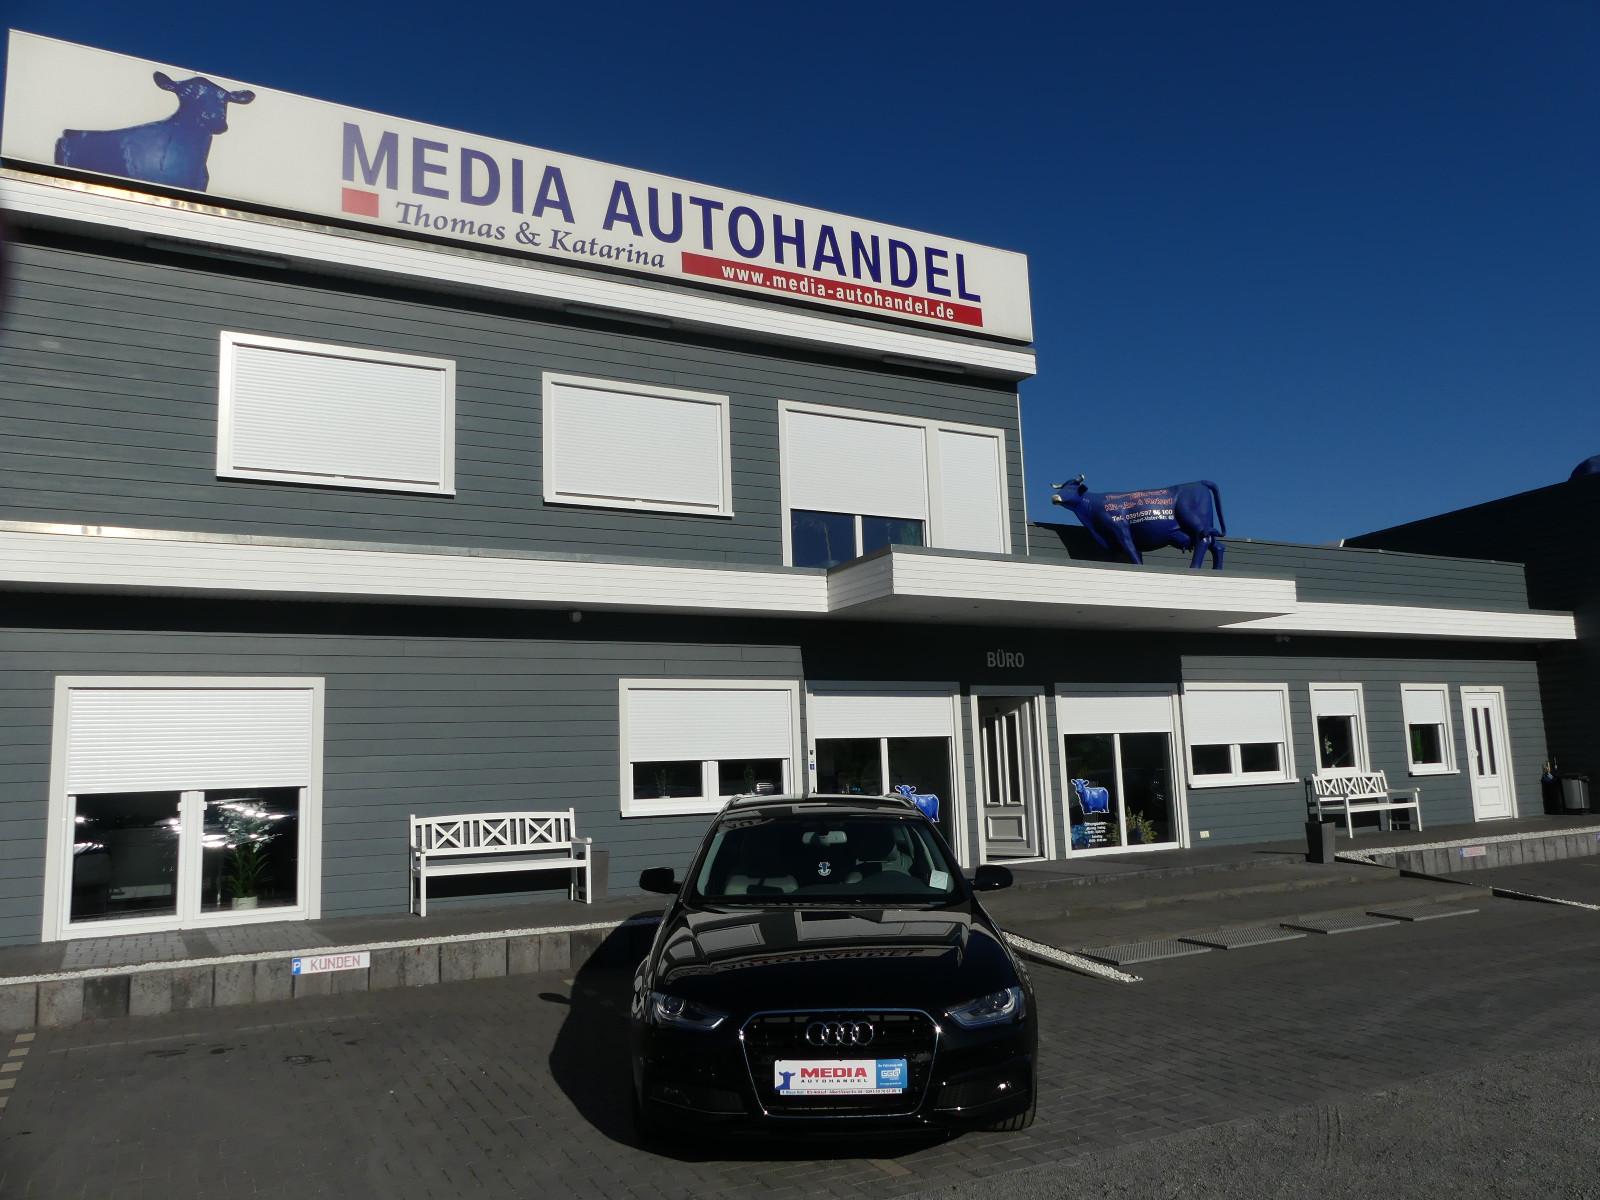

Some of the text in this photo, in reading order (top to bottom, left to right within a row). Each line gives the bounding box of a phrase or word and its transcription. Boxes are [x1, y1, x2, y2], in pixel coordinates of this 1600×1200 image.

[341, 121, 982, 302] MEDIA AUTOHANDEL
[395, 201, 666, 269] Thomas & Katarina
[721, 264, 955, 320] www.media-autohandel.de
[986, 649, 1025, 668] BÜRO
[293, 955, 361, 973] P KUNDEN
[800, 1067, 867, 1078] MEDIA
